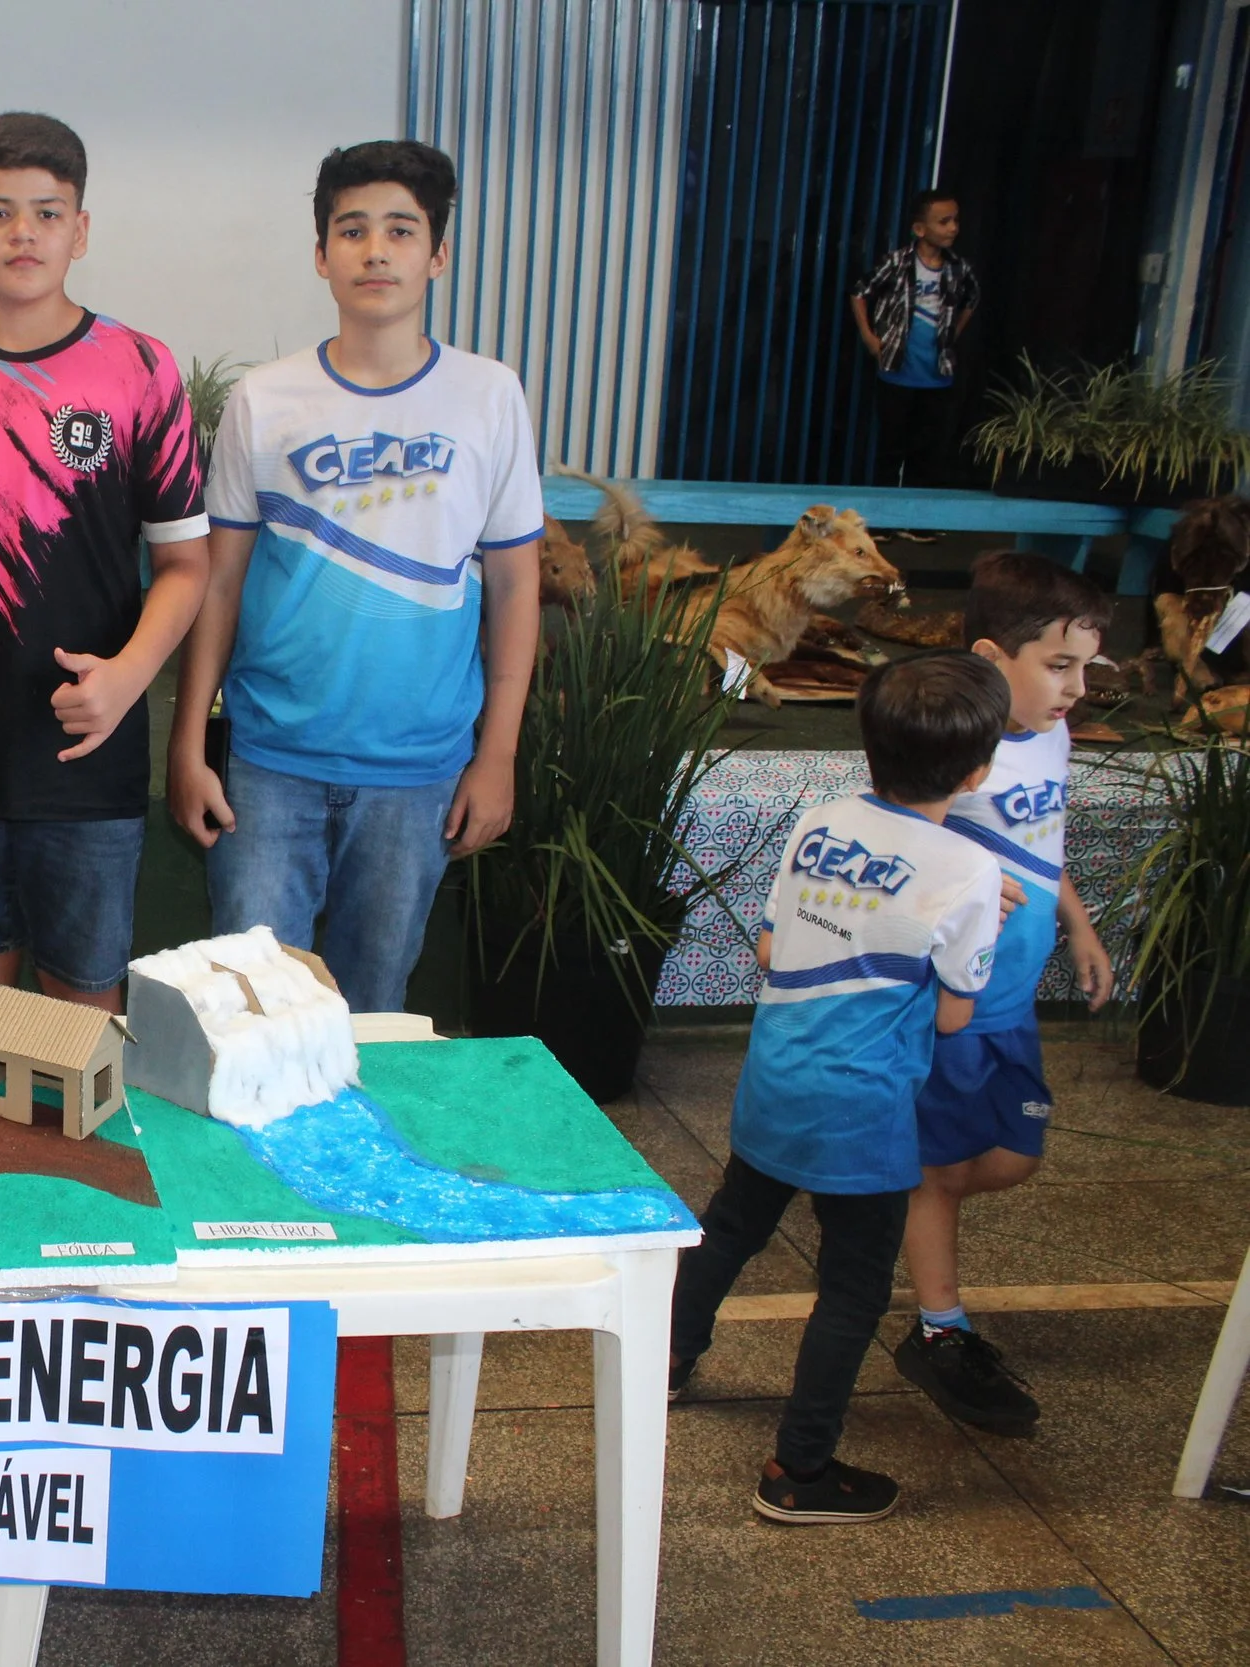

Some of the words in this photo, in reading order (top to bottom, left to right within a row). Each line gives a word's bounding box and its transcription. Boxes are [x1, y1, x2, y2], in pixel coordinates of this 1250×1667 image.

[291, 432, 456, 490] CEART
[996, 780, 1068, 825] CEA
[792, 827, 916, 895] CEART
[797, 907, 853, 941] DOURADOS-MS
